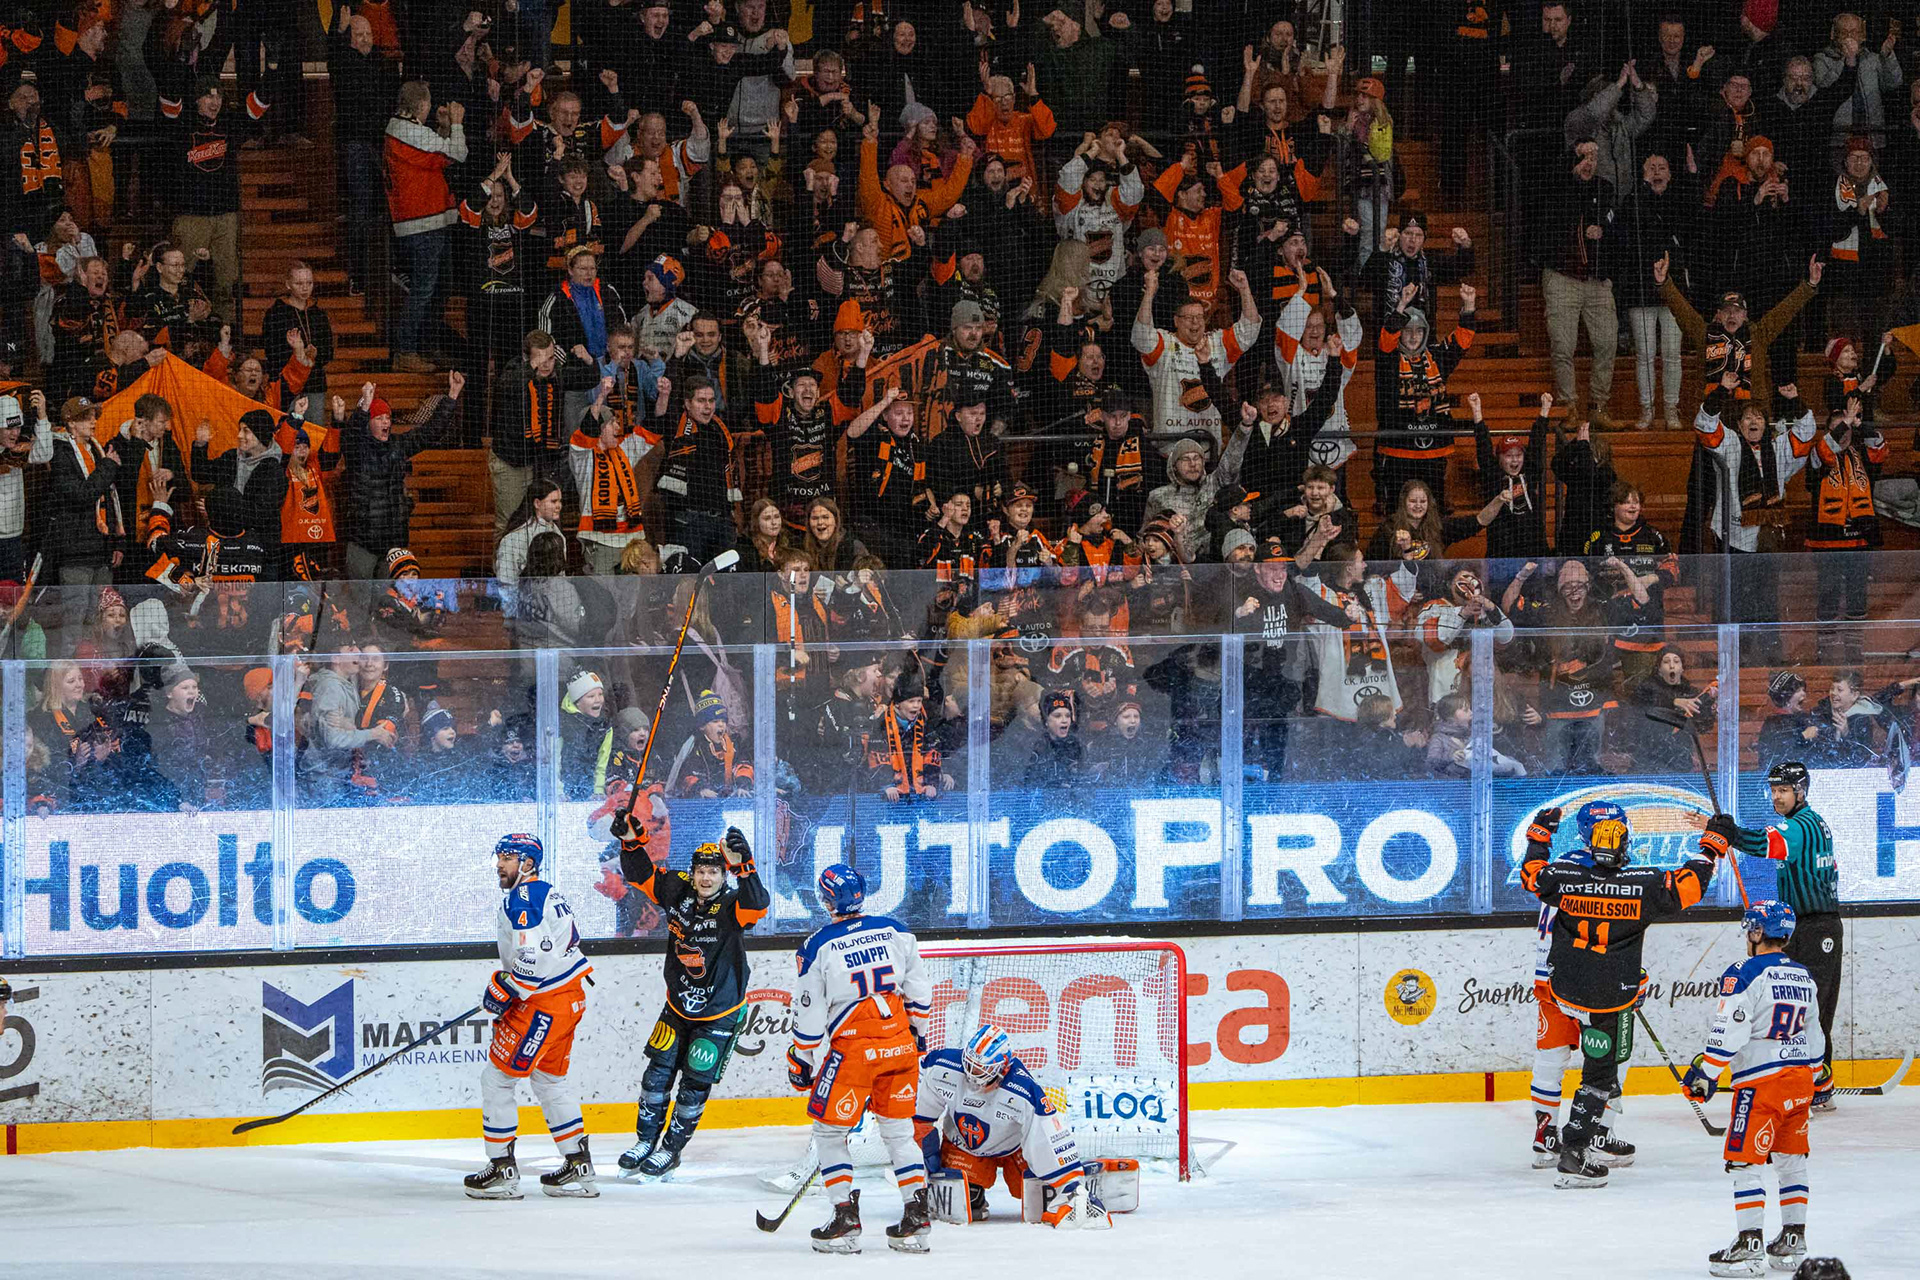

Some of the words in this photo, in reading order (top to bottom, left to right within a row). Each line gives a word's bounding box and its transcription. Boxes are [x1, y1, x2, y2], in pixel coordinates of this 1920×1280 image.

[1090, 269, 1115, 277] AUTO
[1187, 419, 1212, 427] AUTO
[1561, 896, 1638, 918] EMANUELSSON
[518, 911, 528, 927] 4
[838, 932, 893, 951] ÖLJYCENTER
[1573, 920, 1610, 954] 11
[844, 946, 889, 969] SOMPPI
[851, 965, 896, 998] 15
[523, 1014, 551, 1057] Sievi
[1584, 1034, 1608, 1050] MM
[690, 1044, 714, 1063] MM
[817, 1050, 843, 1099] Sievi
[1084, 1090, 1168, 1123] iLOQ
[1733, 1089, 1754, 1135] Sievi
[1544, 1135, 1557, 1150] 10
[501, 1166, 515, 1180] 10
[575, 1163, 590, 1177] 10
[1745, 1237, 1761, 1251] 10
[1785, 1232, 1799, 1247] 10
